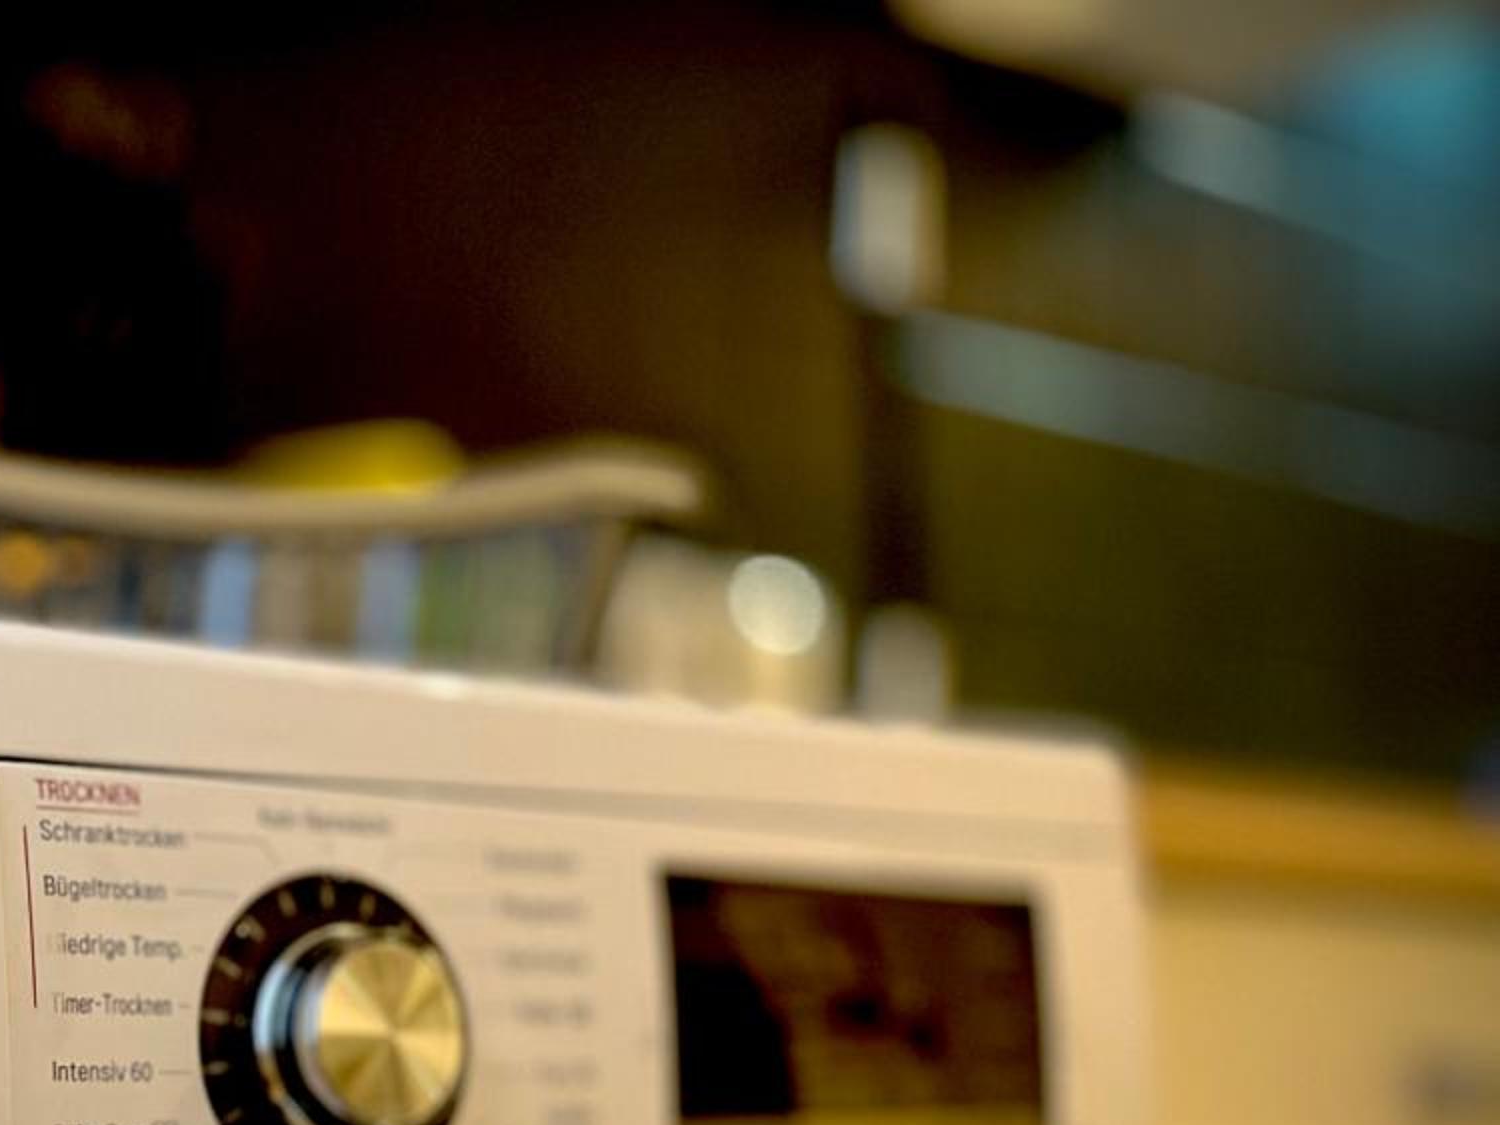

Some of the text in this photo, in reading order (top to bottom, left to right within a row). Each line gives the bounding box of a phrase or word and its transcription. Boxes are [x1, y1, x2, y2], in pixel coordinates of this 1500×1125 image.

[35, 778, 141, 806] TROCKNEN
[39, 818, 186, 850] Schranktrocken
[43, 874, 167, 902] Bügeltrocken
[47, 932, 127, 961] iedrige
[51, 1061, 154, 1083] Intensiv 60
